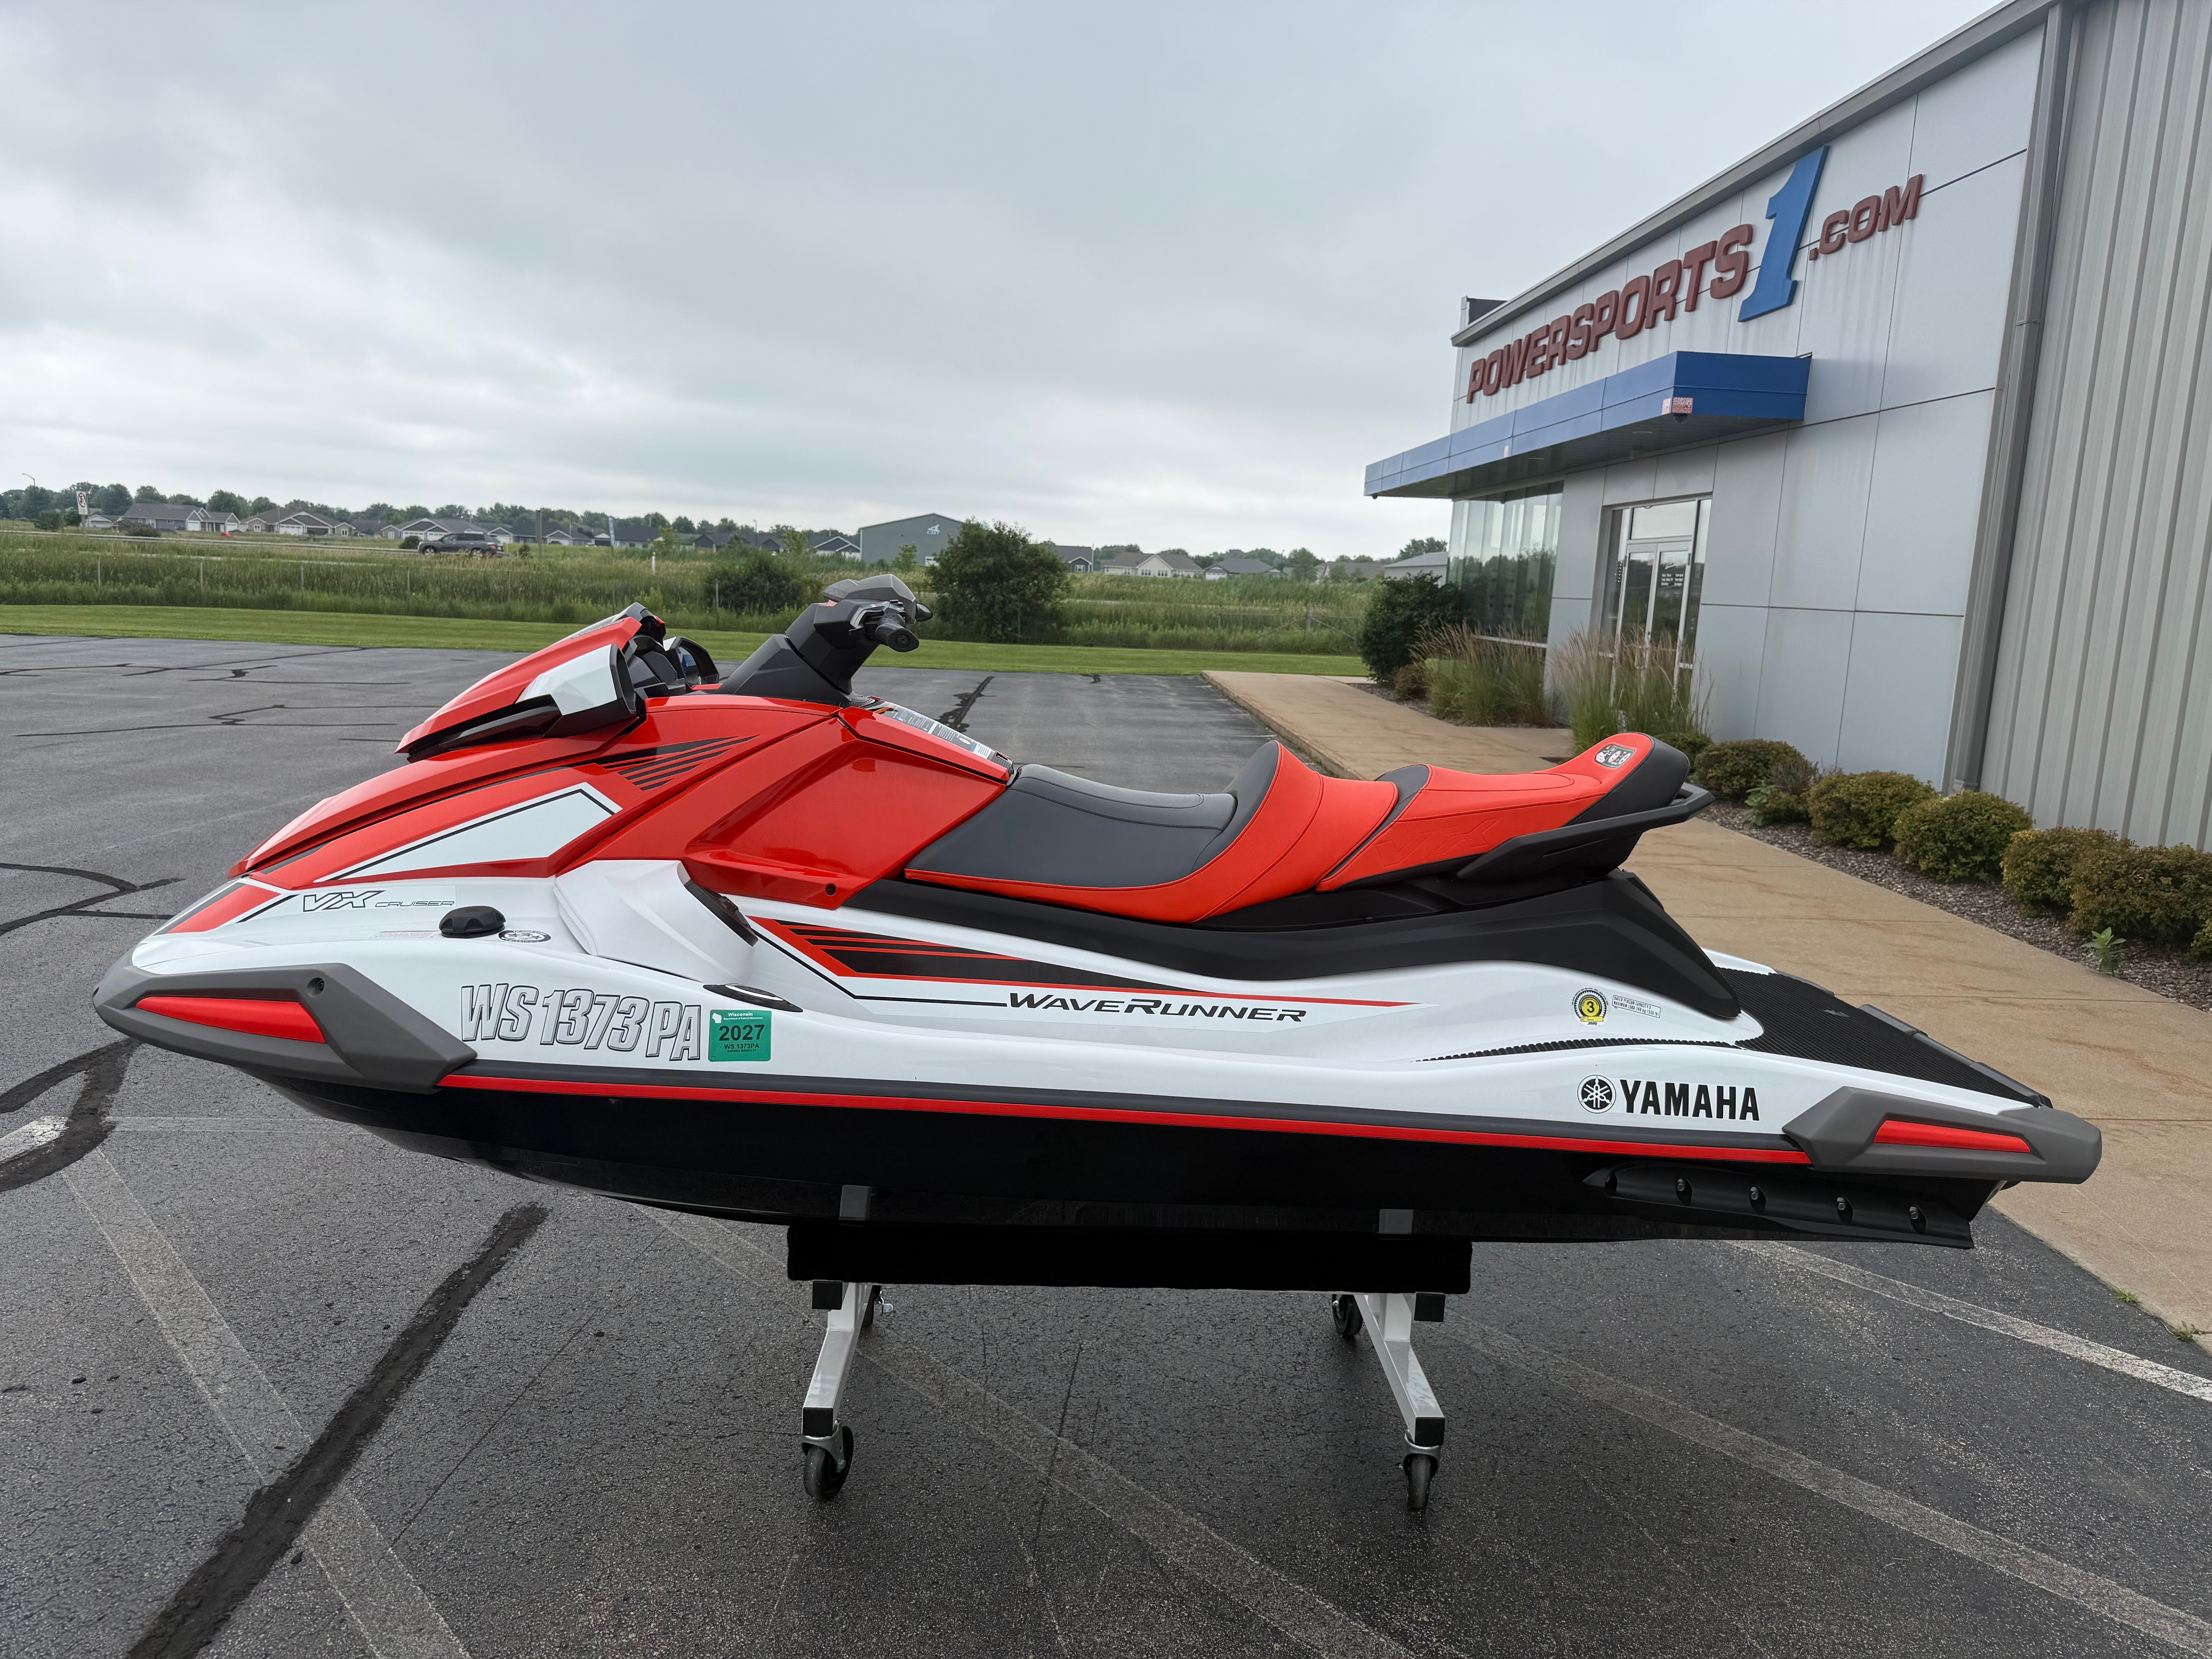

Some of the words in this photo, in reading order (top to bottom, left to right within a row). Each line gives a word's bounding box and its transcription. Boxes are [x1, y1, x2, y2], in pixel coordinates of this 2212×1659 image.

[303, 890, 386, 912] VX
[1587, 1001, 1595, 1013] 3
[461, 983, 539, 1042] WS
[540, 988, 649, 1052] 1373
[646, 1001, 701, 1061] PA
[719, 1024, 765, 1041] 2027
[1620, 1079, 1760, 1121] YAMAHA
